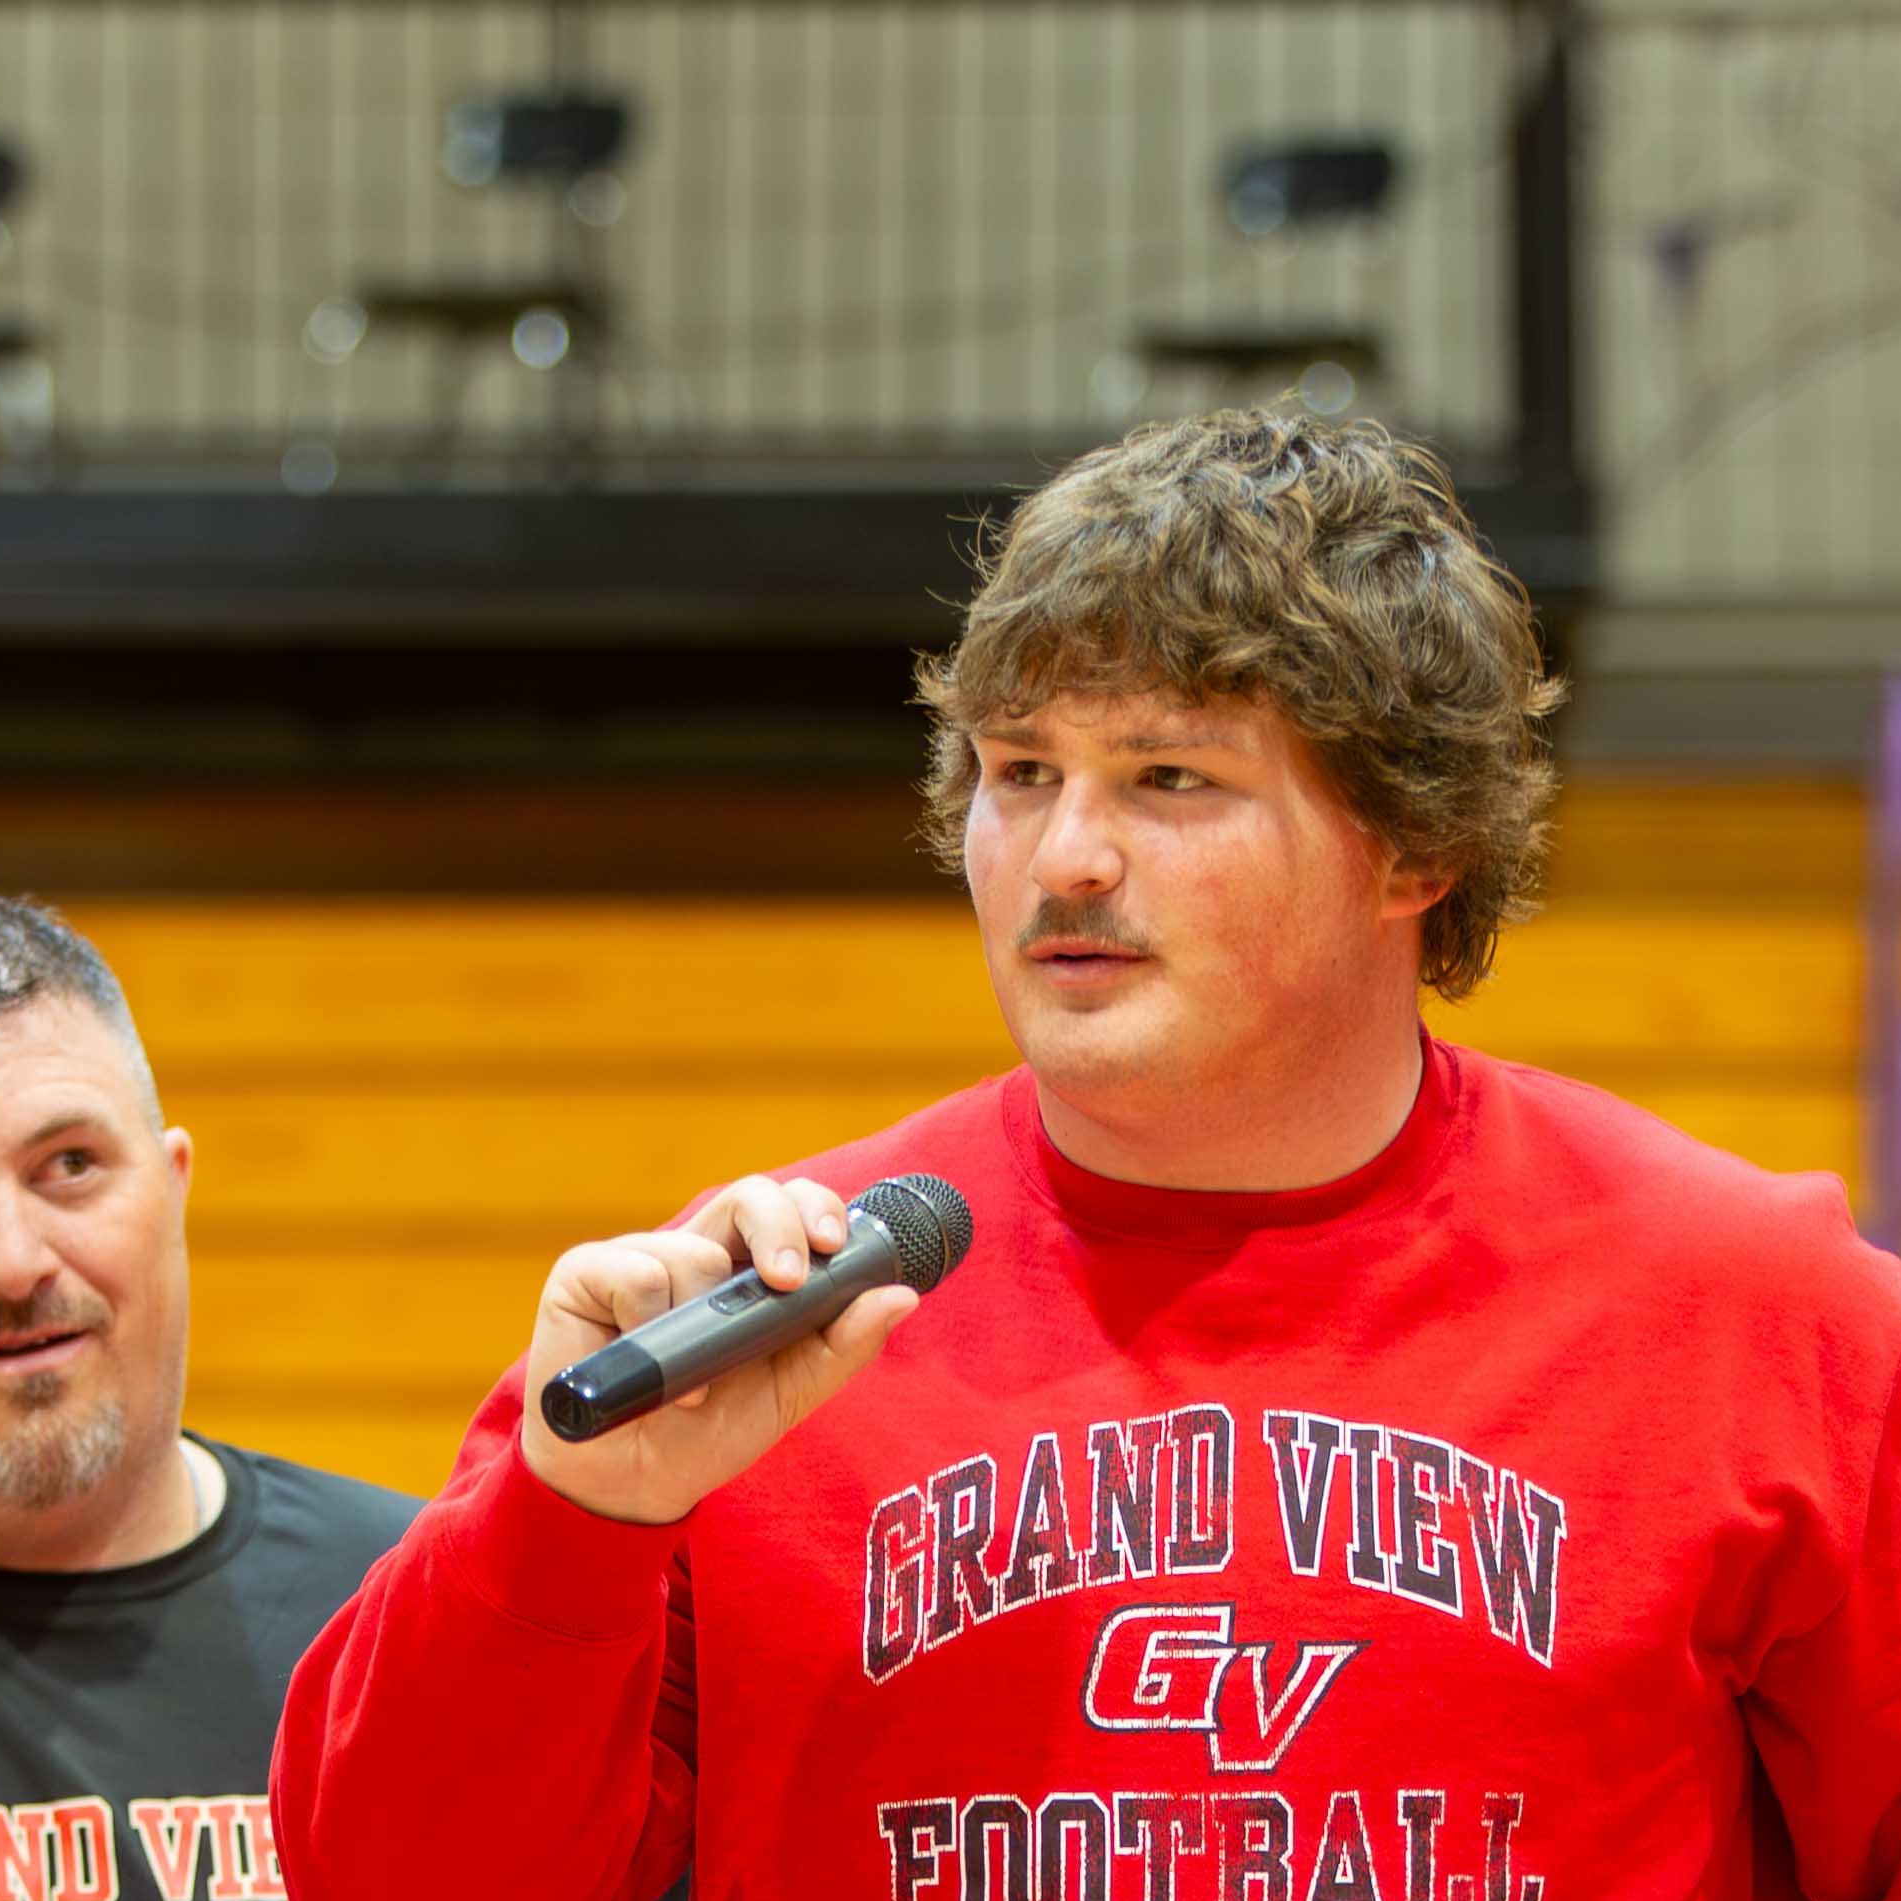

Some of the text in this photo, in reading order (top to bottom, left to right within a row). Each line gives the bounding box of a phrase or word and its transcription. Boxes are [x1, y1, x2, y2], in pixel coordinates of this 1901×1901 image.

[863, 1402, 1567, 1686] GRAND VIEW
[1079, 1602, 1373, 1776] GV
